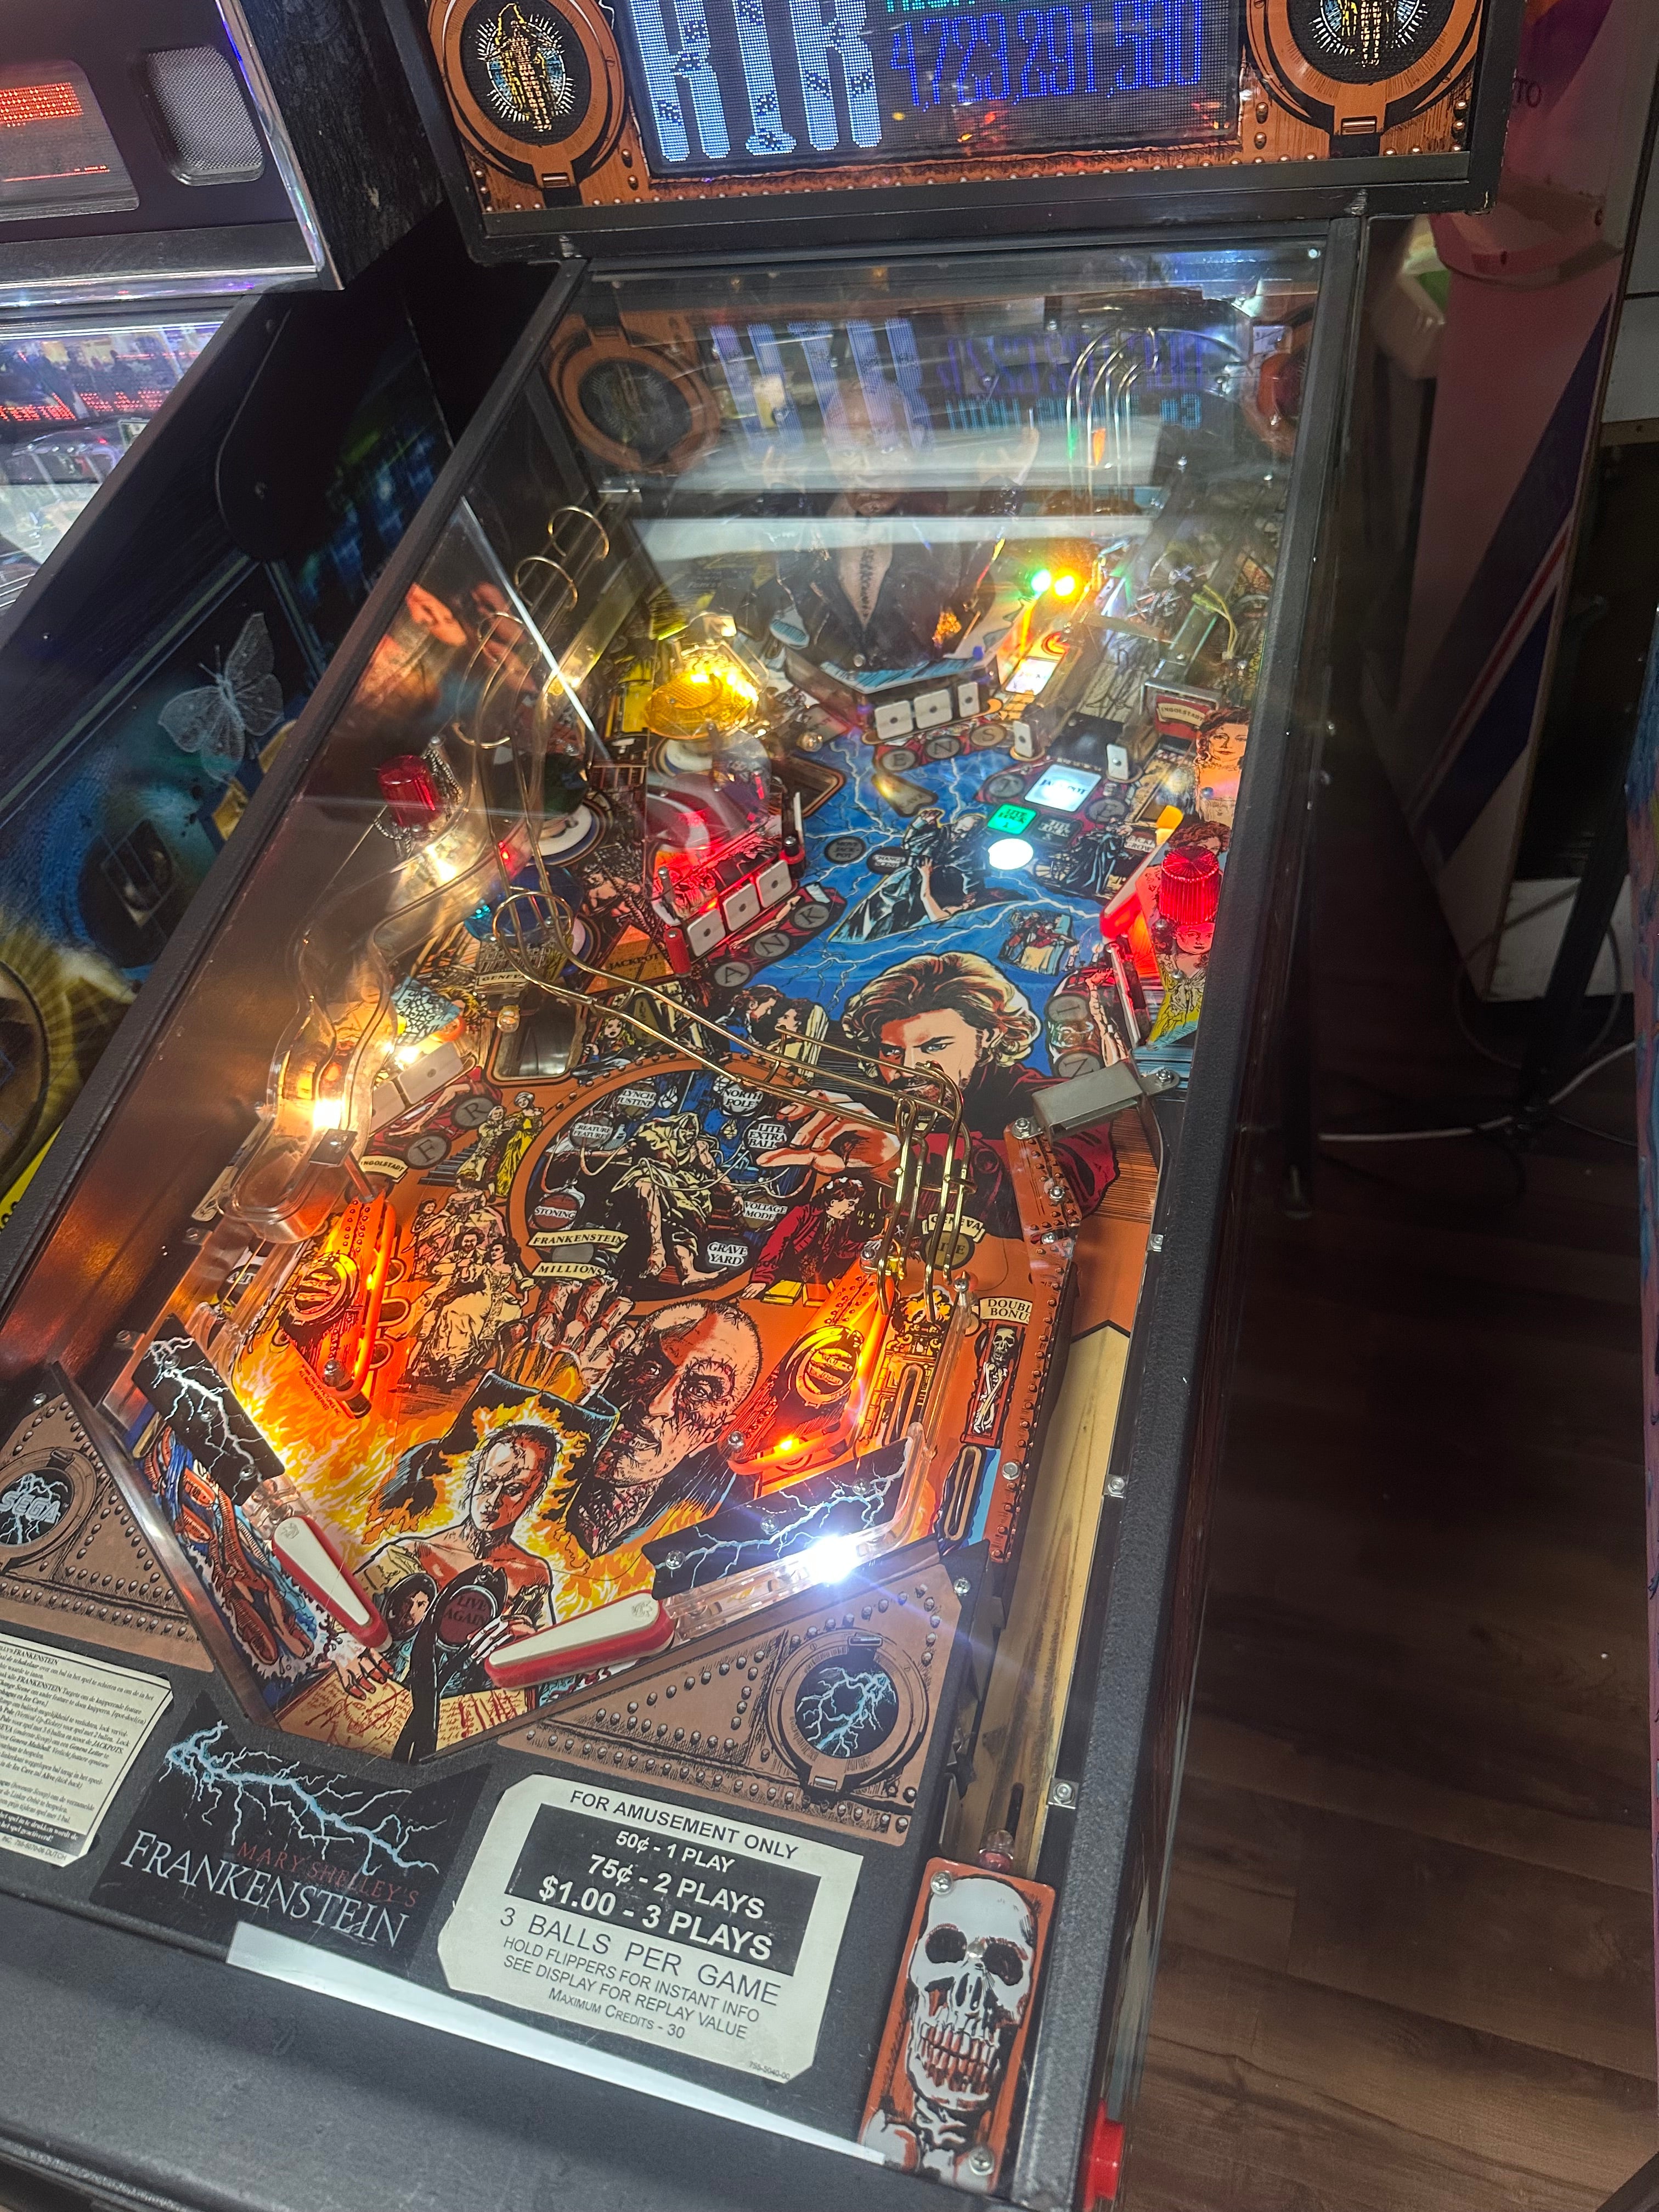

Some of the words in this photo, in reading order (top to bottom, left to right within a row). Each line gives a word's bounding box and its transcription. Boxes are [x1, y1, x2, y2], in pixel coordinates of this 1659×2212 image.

[934, 741, 953, 755] N
[798, 906, 825, 925] K
[759, 934, 787, 956] N
[609, 952, 659, 970] JACKPOT
[725, 966, 747, 984] A
[623, 1088, 655, 1099] LYNCH
[724, 1088, 763, 1100] NORTH
[618, 1096, 654, 1108] JUSTINE
[725, 1097, 756, 1109] POLE
[462, 1102, 488, 1121] R
[573, 1123, 612, 1133] CREATURE
[573, 1130, 607, 1140] FEATURE
[759, 1124, 784, 1133] LITE
[749, 1131, 786, 1142] EXTRA
[749, 1138, 777, 1149] BALL
[414, 1138, 436, 1163] F
[534, 1207, 577, 1219] STONING
[744, 1201, 787, 1214] VOLTAGE
[744, 1210, 775, 1221] MODE
[533, 1233, 625, 1245] FRANKENSTEIN
[708, 1243, 748, 1256] GRAVE
[709, 1252, 743, 1266] YARD
[538, 1265, 603, 1277] MILLIONS
[988, 1298, 1031, 1314] DOUBL
[990, 1307, 1030, 1323] BONU
[314, 1391, 330, 1411] RESERVED
[0, 1490, 61, 1524] SEGA
[457, 1597, 488, 1611] LIVE
[443, 1608, 489, 1626] AGAIN
[13, 1648, 58, 1665] FRANKENSTEIN
[97, 1681, 117, 1691] schieten
[16, 1675, 61, 1692] FRANKENSTEIN
[62, 1687, 80, 1698] Targets
[124, 1705, 142, 1714] feature
[116, 1737, 129, 1747] Lock
[570, 1790, 610, 1812] FOR
[612, 1802, 740, 1843] AMUSEMENT
[744, 1834, 799, 1859] ONLY
[236, 1841, 307, 1872] MARY
[616, 1831, 650, 1854] 50¢
[667, 1843, 676, 1858] 1
[681, 1847, 735, 1872] PLAY
[120, 1830, 410, 1949] FRANKENSTEIN
[307, 1860, 420, 1908] SHELLEY'S
[588, 1854, 633, 1886] 75¢
[653, 1872, 672, 1894] 2
[676, 1878, 764, 1918] PLAYS
[539, 1875, 616, 1915] $1.00
[642, 1904, 661, 1928] 3
[668, 1911, 772, 1960] PLAYS
[500, 1907, 515, 1926] 3
[528, 1914, 611, 1954] BALLS
[624, 1942, 681, 1976] PER
[698, 1964, 781, 2006] GAME
[503, 1936, 543, 1957] HOLD
[546, 1948, 617, 1979] FLIPPERS
[619, 1970, 651, 1990] FOR
[654, 1980, 718, 2009] INSTANT
[722, 2000, 759, 2022] INFO
[504, 1955, 534, 1974] SEE
[535, 1964, 597, 1991] DISPLAY
[599, 1983, 631, 2004] FOR
[634, 1993, 695, 2021] REPLAY
[698, 2012, 748, 2039] VALUE
[667, 2023, 685, 2039] 30
